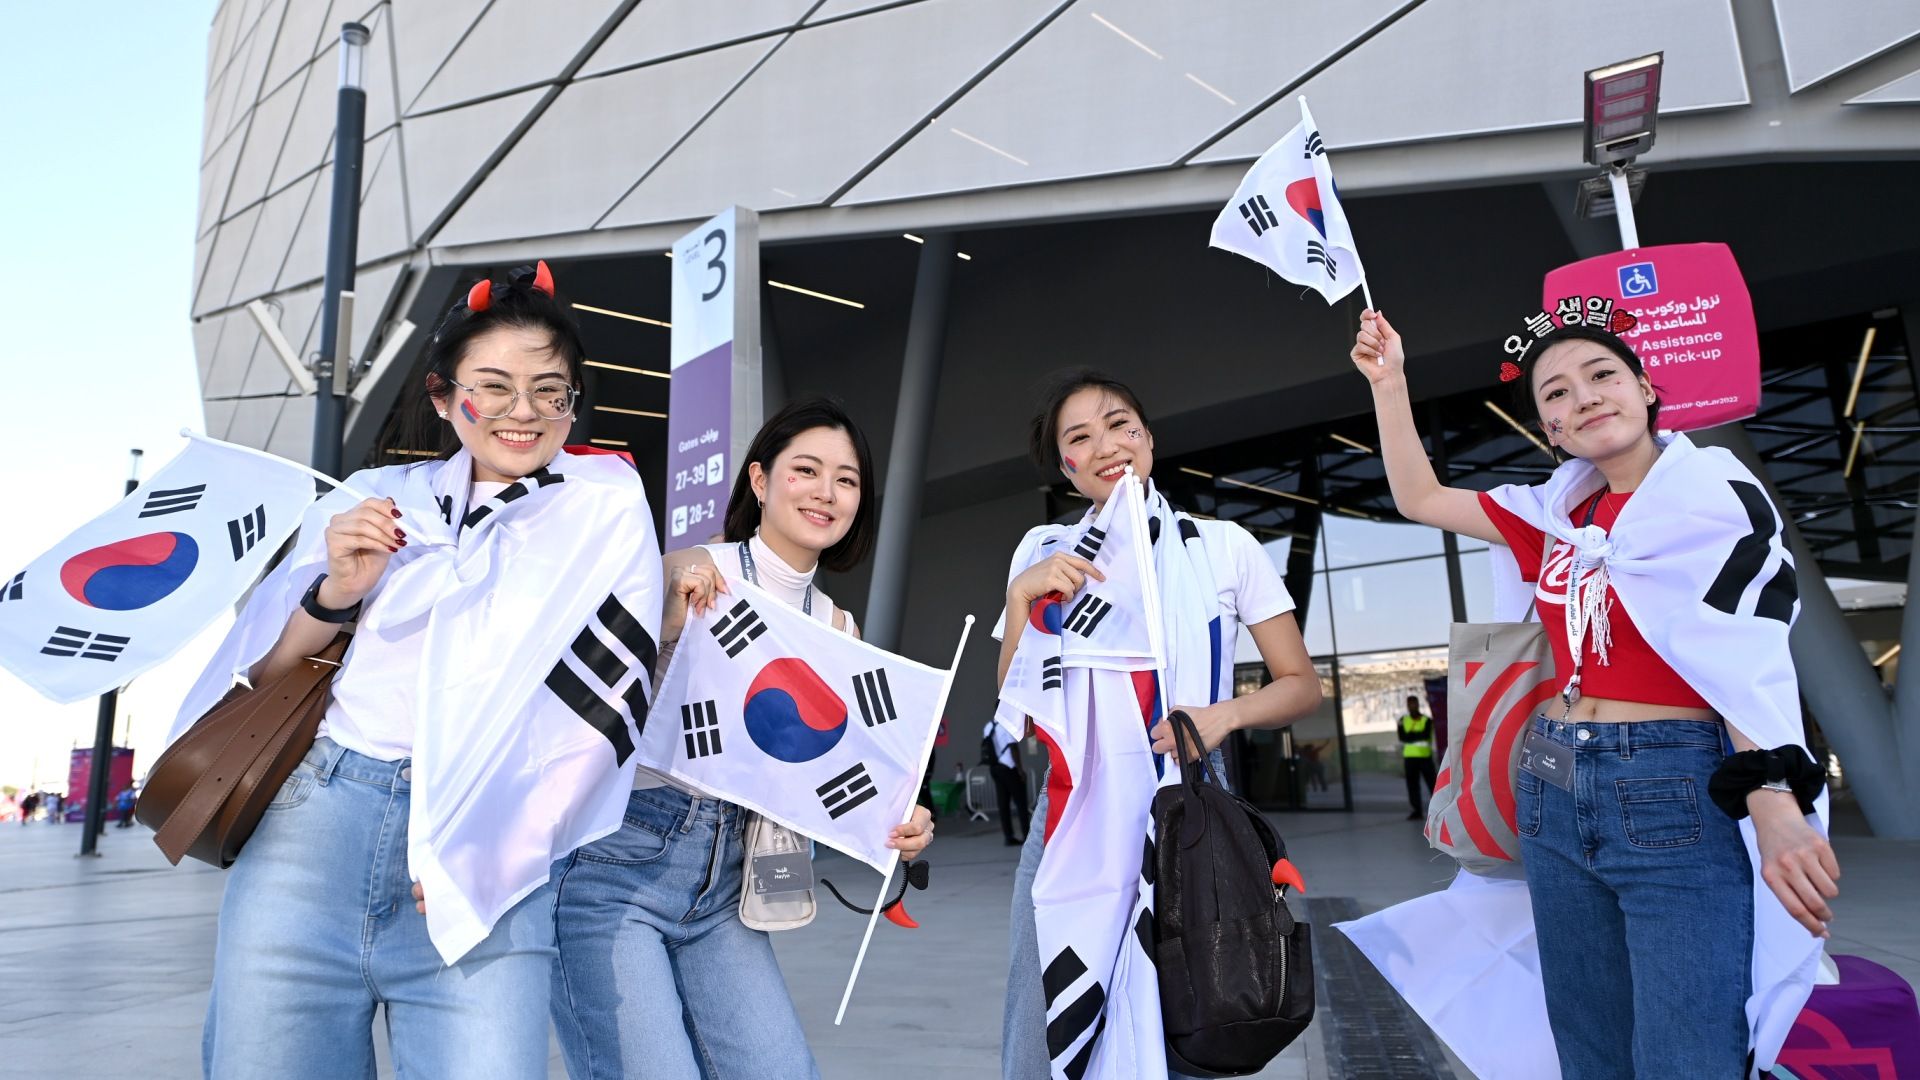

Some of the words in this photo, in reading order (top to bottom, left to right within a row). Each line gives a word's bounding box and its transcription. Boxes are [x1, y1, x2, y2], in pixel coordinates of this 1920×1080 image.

[702, 228, 727, 302] 3
[1646, 300, 1688, 317] وركوب
[1690, 294, 1720, 311] نزول
[1653, 312, 1707, 330] المساعدة
[1641, 331, 1723, 351] Assistance
[1649, 355, 1661, 367] &
[1664, 348, 1722, 365] Pick-up
[678, 437, 699, 453] Gates
